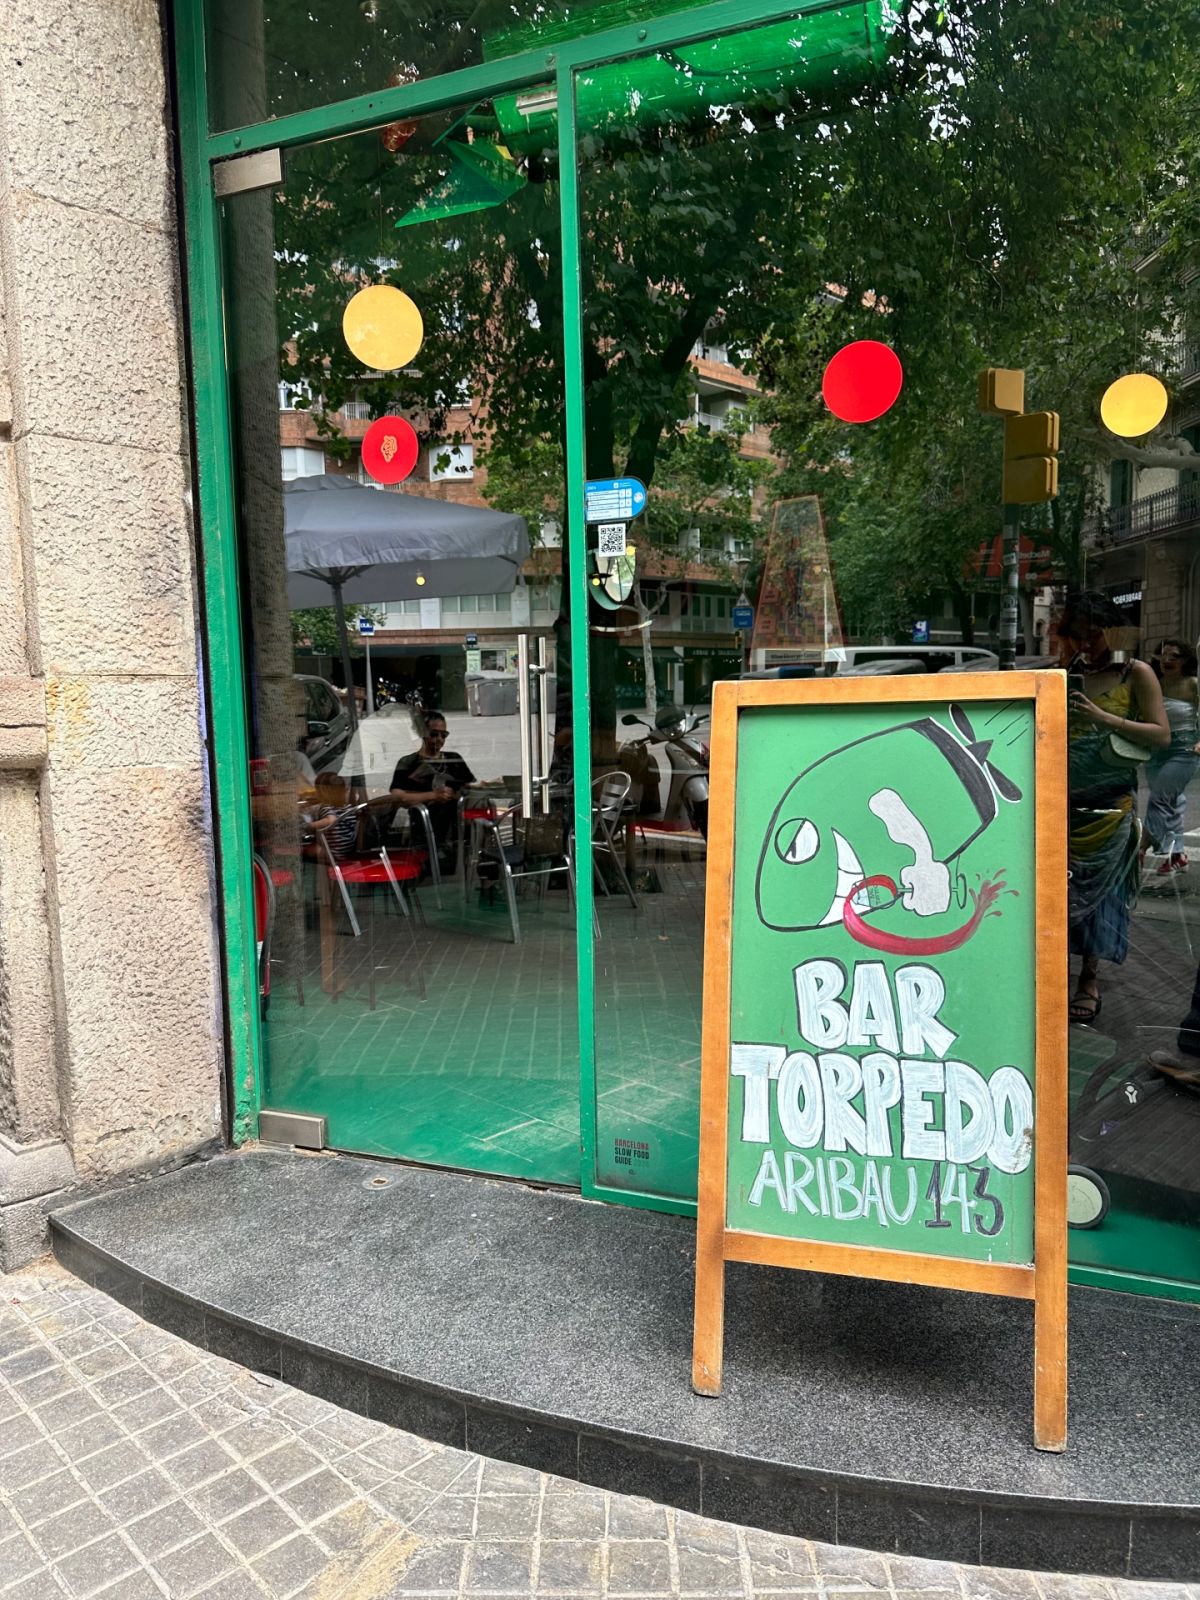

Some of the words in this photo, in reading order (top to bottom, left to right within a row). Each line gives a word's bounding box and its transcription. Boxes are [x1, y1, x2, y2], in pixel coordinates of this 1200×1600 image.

[793, 956, 959, 1059] BAR
[731, 1041, 1035, 1175] TORPEDO
[615, 1138, 648, 1150] BARCELONA
[615, 1147, 631, 1156] SLOW
[634, 1150, 649, 1159] FOOD
[615, 1156, 632, 1165] GUIDE
[748, 1149, 918, 1228] ARIBAU
[924, 1161, 1006, 1236] 143
